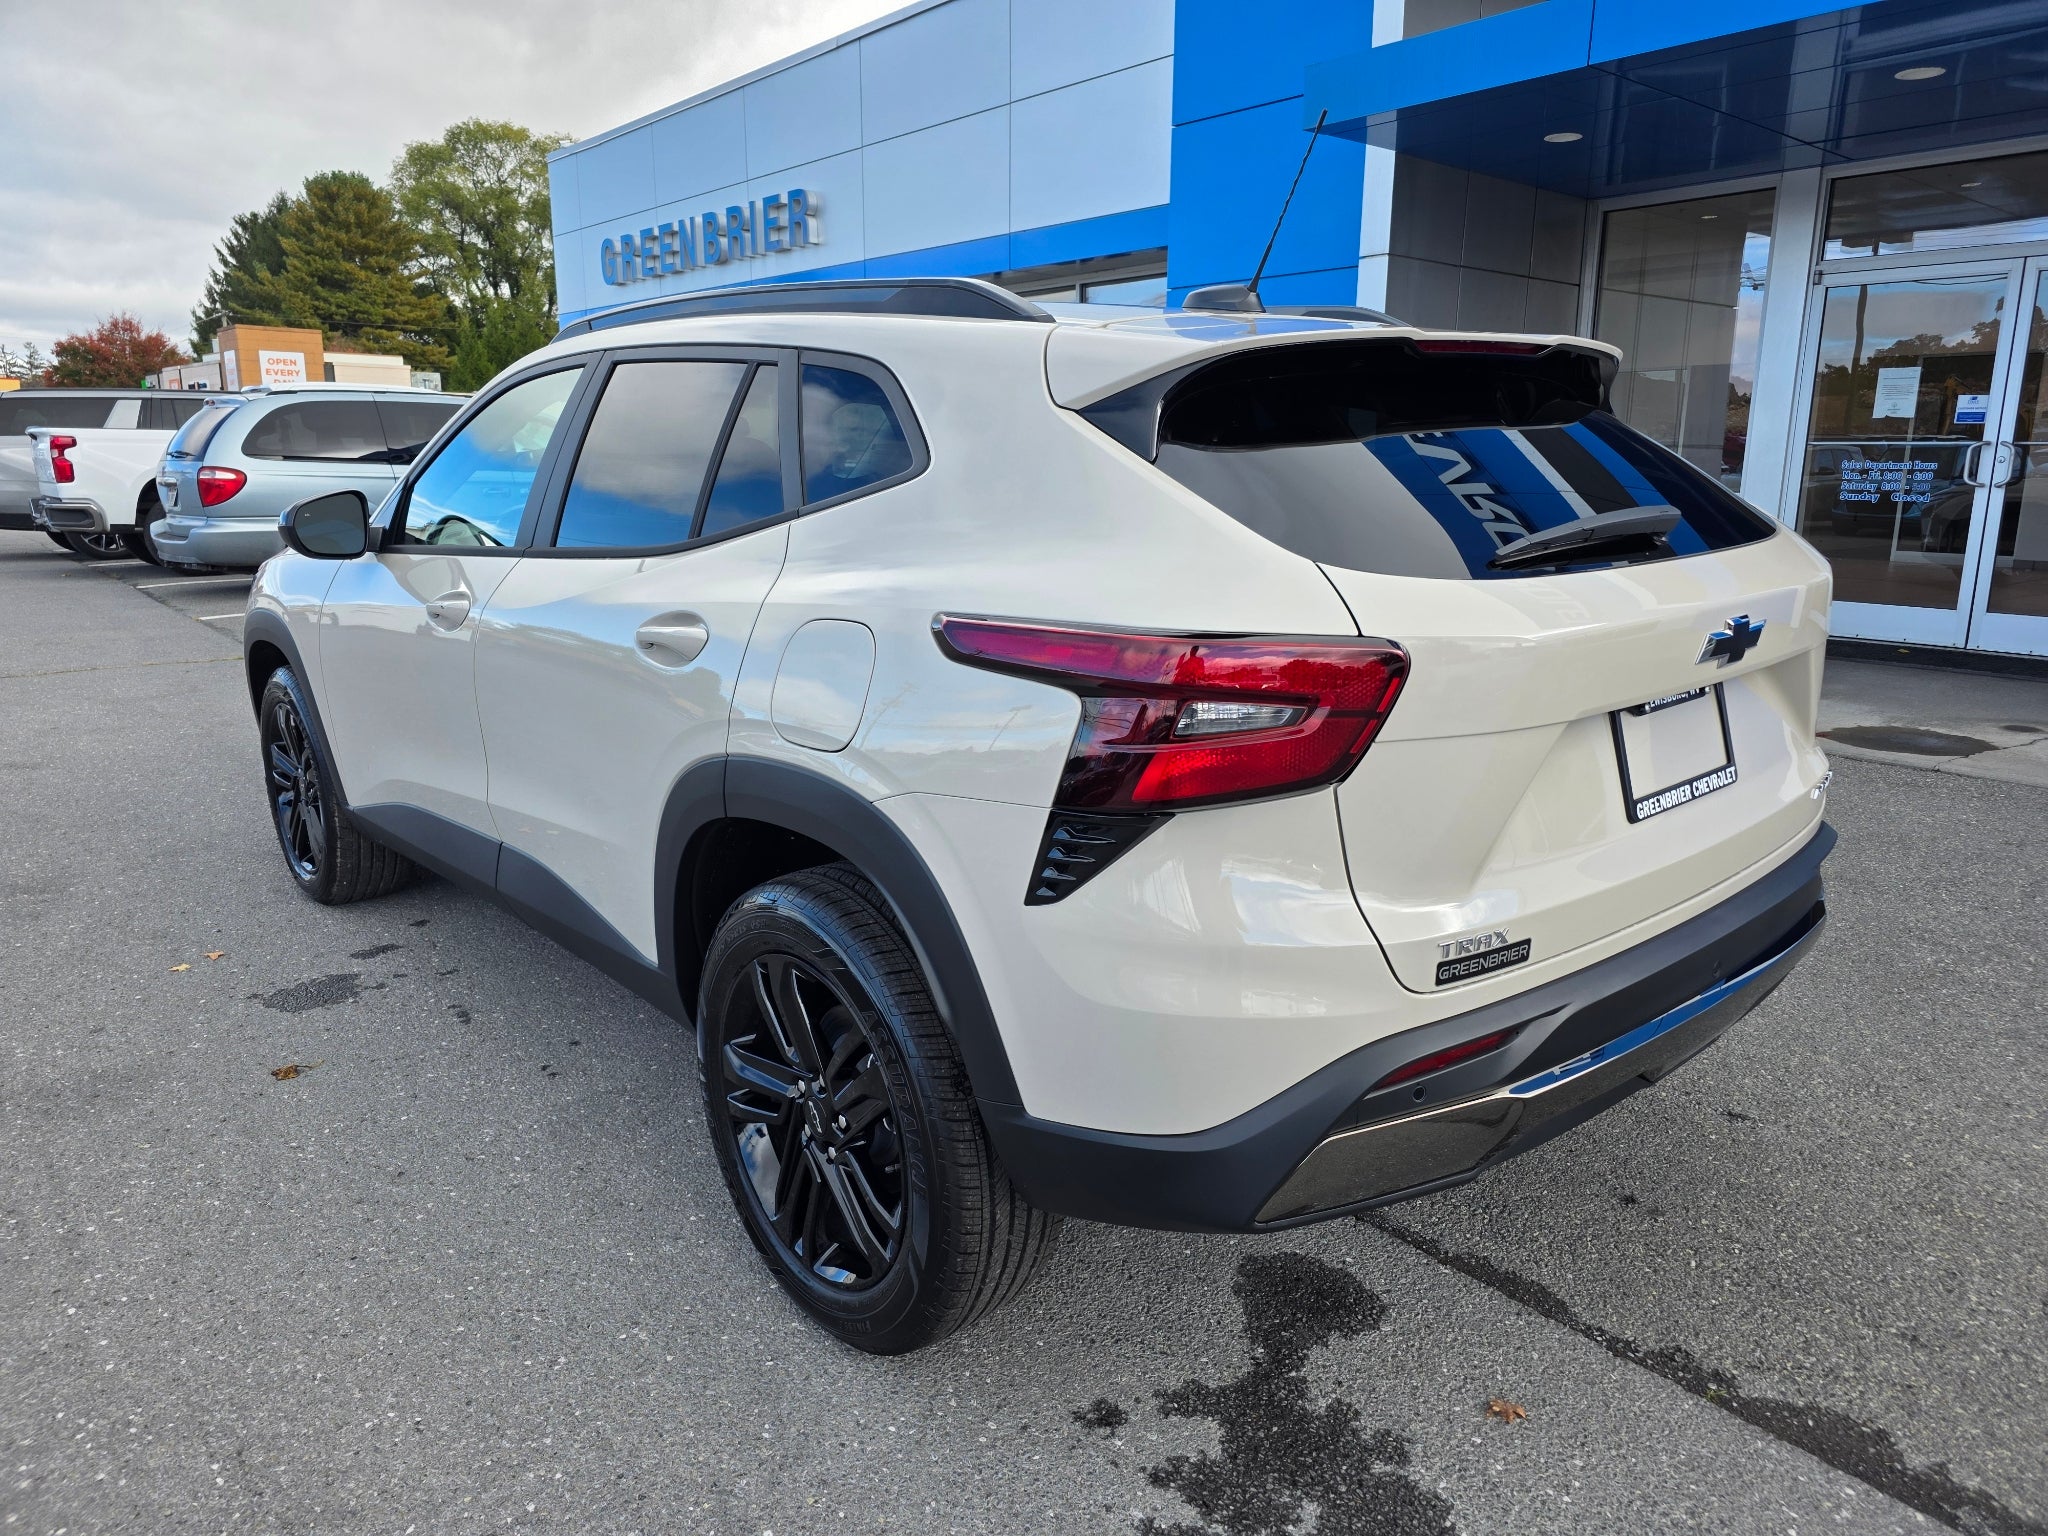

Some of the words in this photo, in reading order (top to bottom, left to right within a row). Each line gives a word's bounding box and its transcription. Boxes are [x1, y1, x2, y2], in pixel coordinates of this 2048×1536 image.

[601, 189, 814, 286] GREENBRIER
[267, 358, 297, 367] OPEN
[265, 368, 300, 377] EVERY
[1841, 459, 1862, 469] Sales
[1864, 460, 1912, 471] Department
[1913, 461, 1938, 470] Hours
[1883, 472, 1903, 480] 8:00
[1912, 472, 1934, 481] 6:00
[1840, 481, 1878, 492] Saturday
[1881, 482, 1902, 491] 8:00
[1839, 491, 1880, 503] Sunday
[1890, 492, 1931, 503] Closed
[1636, 784, 1692, 820] GREENBRIER
[1692, 766, 1737, 797] CHEVROLET
[1438, 927, 1510, 959] TRAX
[1438, 944, 1530, 980] GREENBRIER
